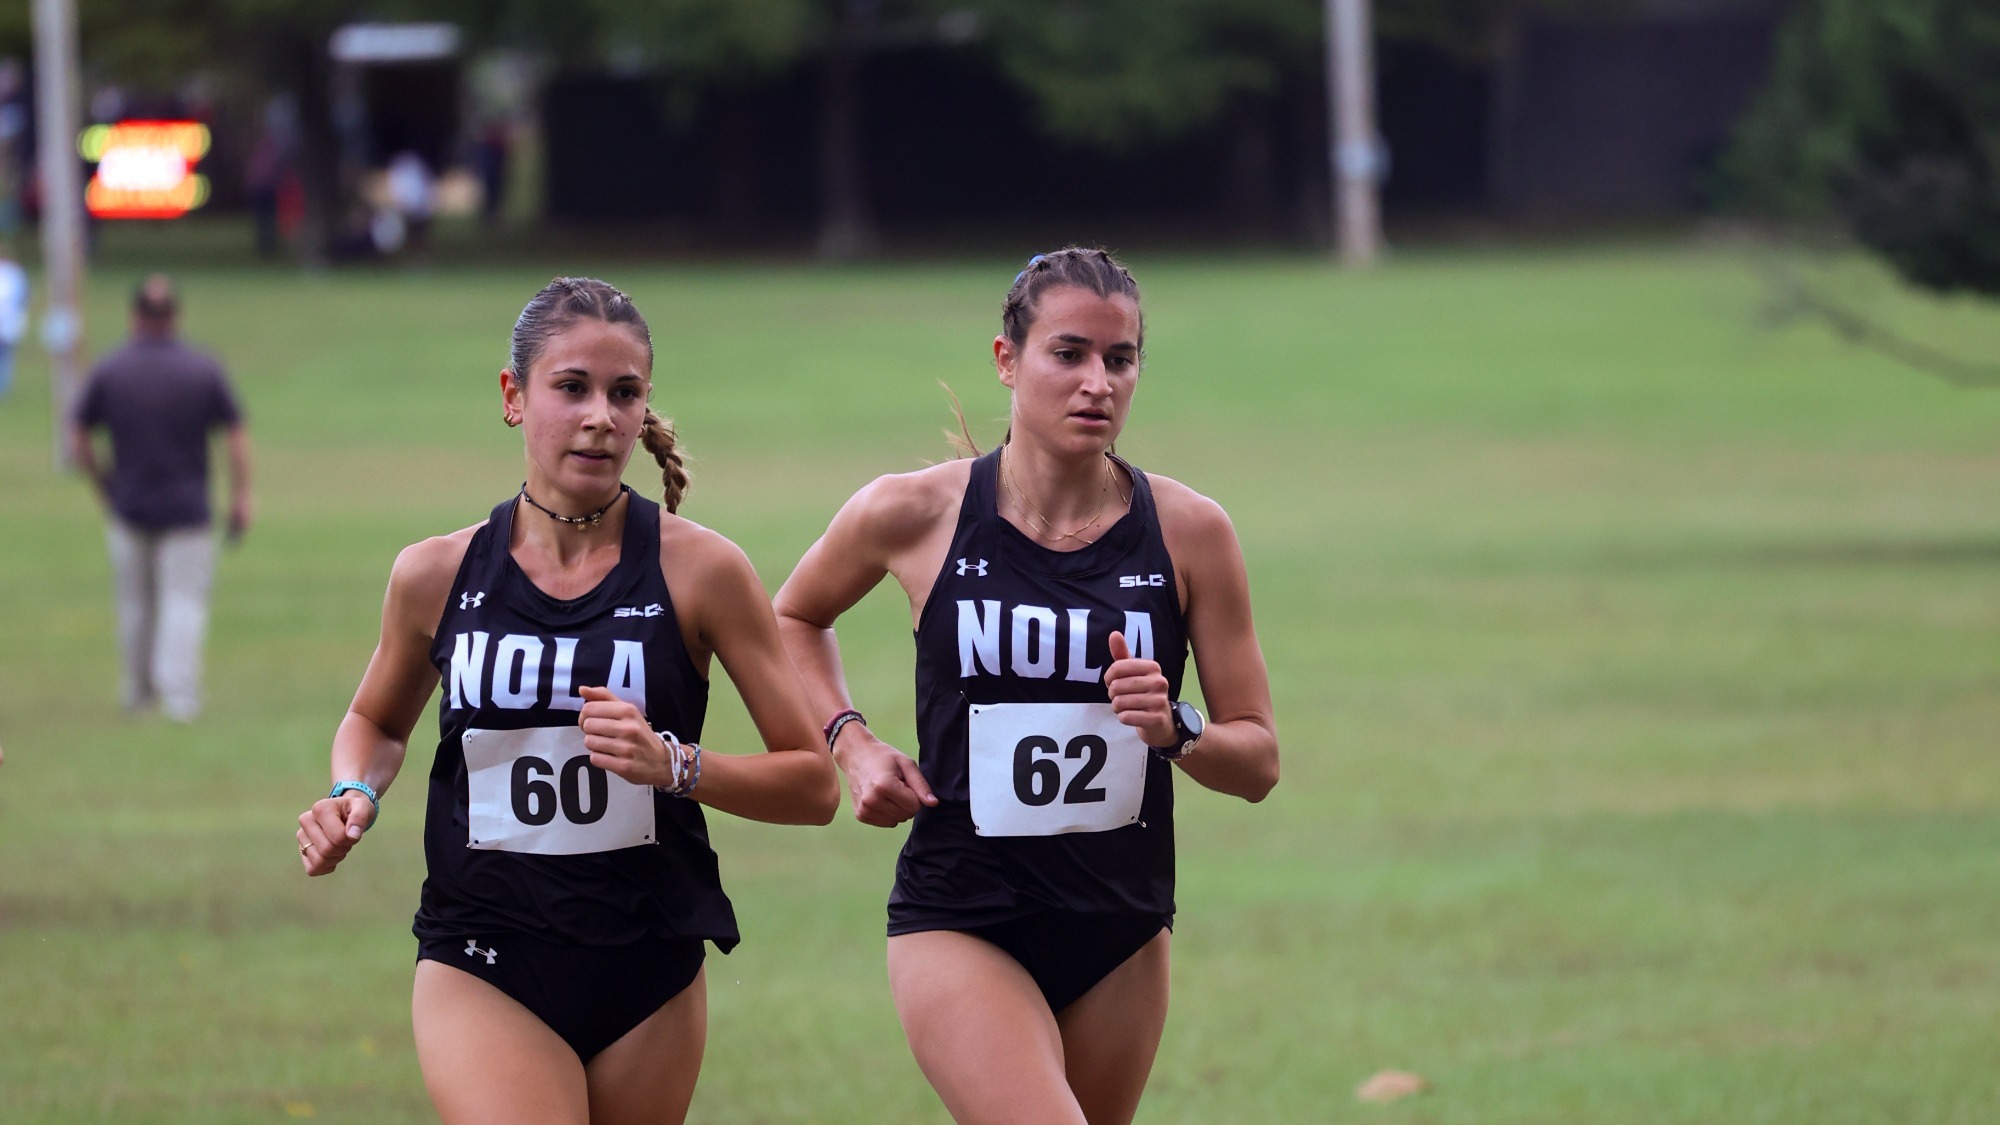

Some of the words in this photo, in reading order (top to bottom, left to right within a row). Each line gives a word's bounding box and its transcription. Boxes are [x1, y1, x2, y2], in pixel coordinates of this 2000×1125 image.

[450, 631, 648, 718] NOLA
[956, 599, 1154, 684] NOLA
[510, 754, 609, 826] 60
[1012, 734, 1108, 807] 62
